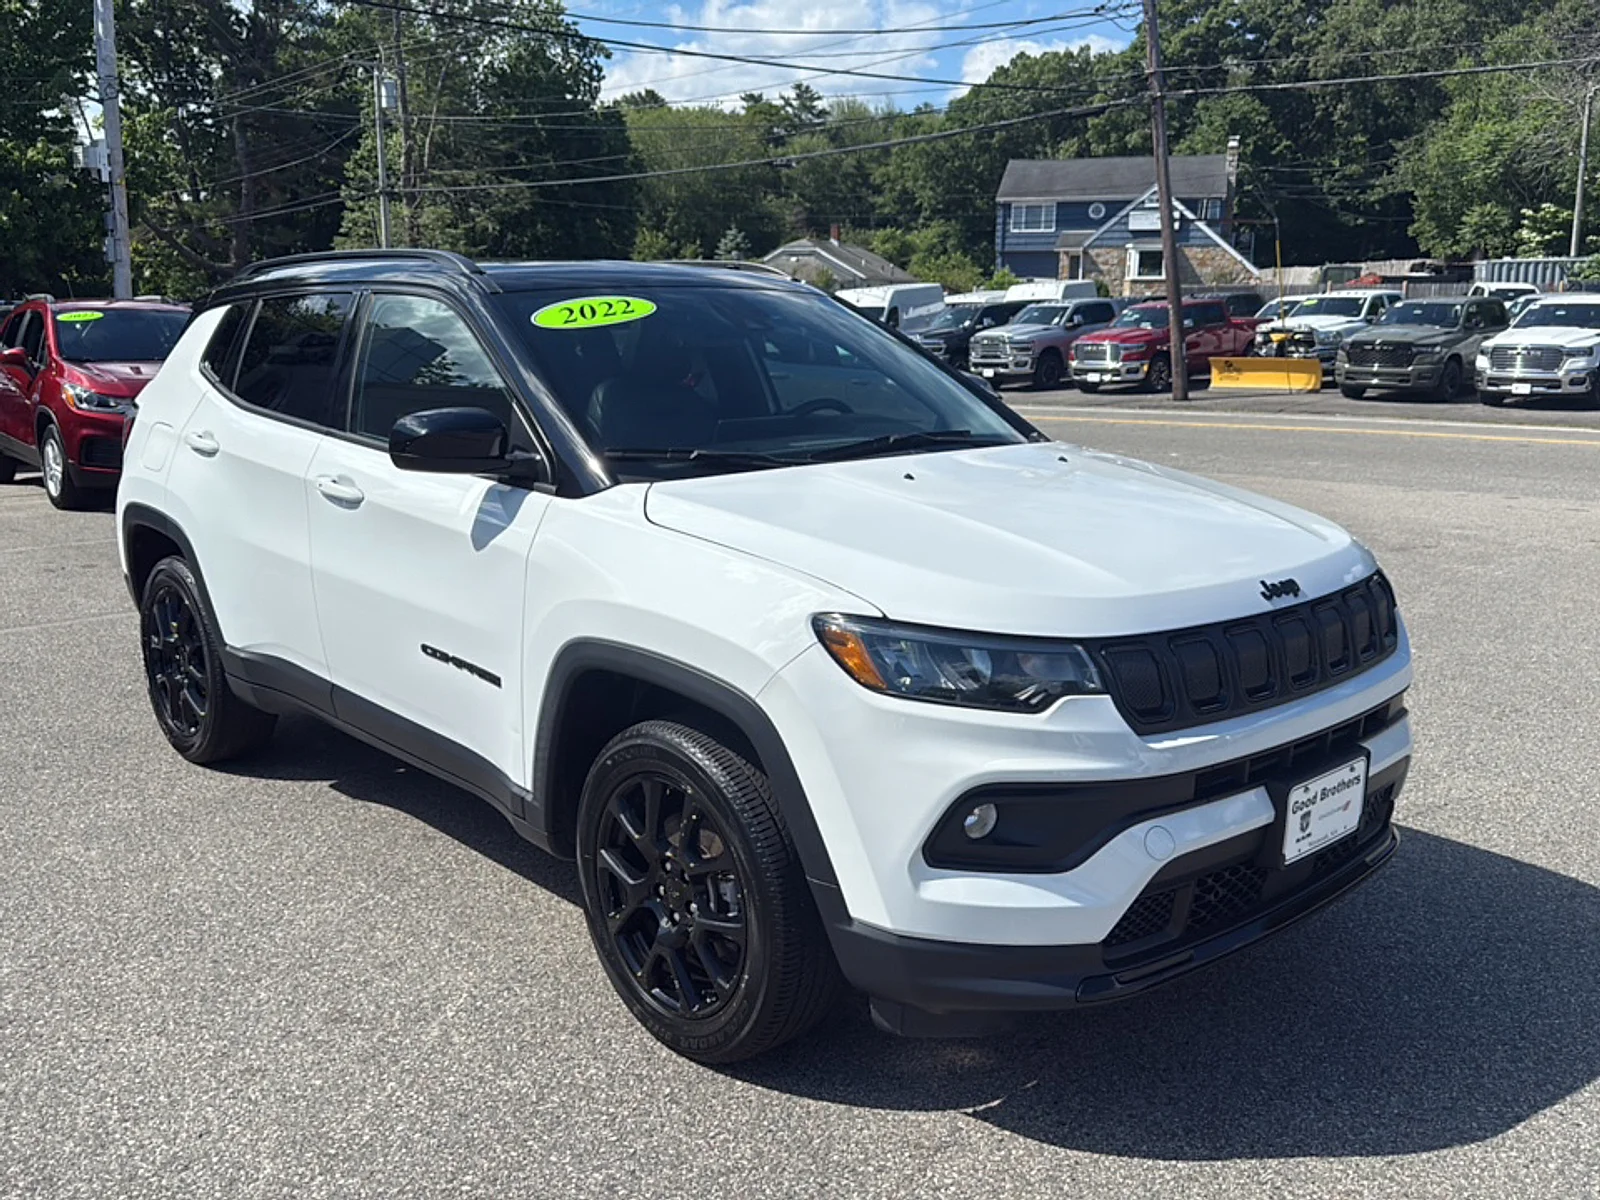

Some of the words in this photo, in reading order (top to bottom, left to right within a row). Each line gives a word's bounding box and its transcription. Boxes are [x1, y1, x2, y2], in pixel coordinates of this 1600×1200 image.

[558, 299, 634, 324] 2022
[1260, 578, 1301, 601] Jeep
[1292, 791, 1318, 814] Good
[1320, 775, 1361, 801] Brothers
